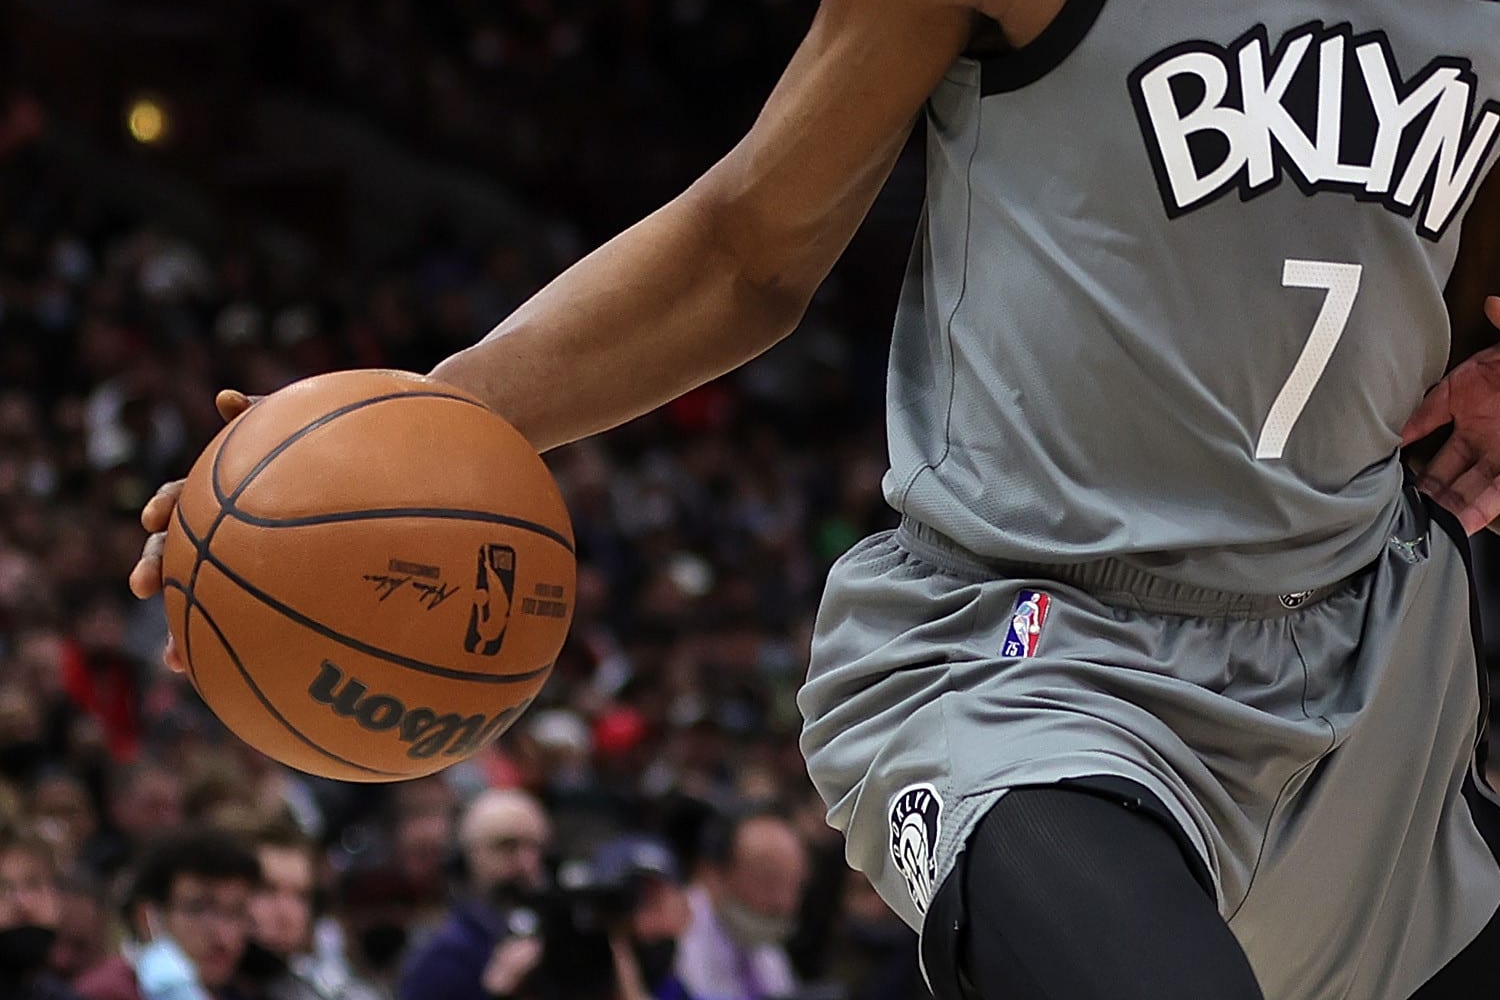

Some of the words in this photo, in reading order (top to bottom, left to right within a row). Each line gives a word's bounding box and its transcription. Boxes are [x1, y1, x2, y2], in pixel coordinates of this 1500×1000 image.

[1141, 33, 1500, 231] BKLYN
[1256, 260, 1362, 459] 7
[1004, 640, 1020, 657] 75
[892, 790, 931, 900] OOKLYN
